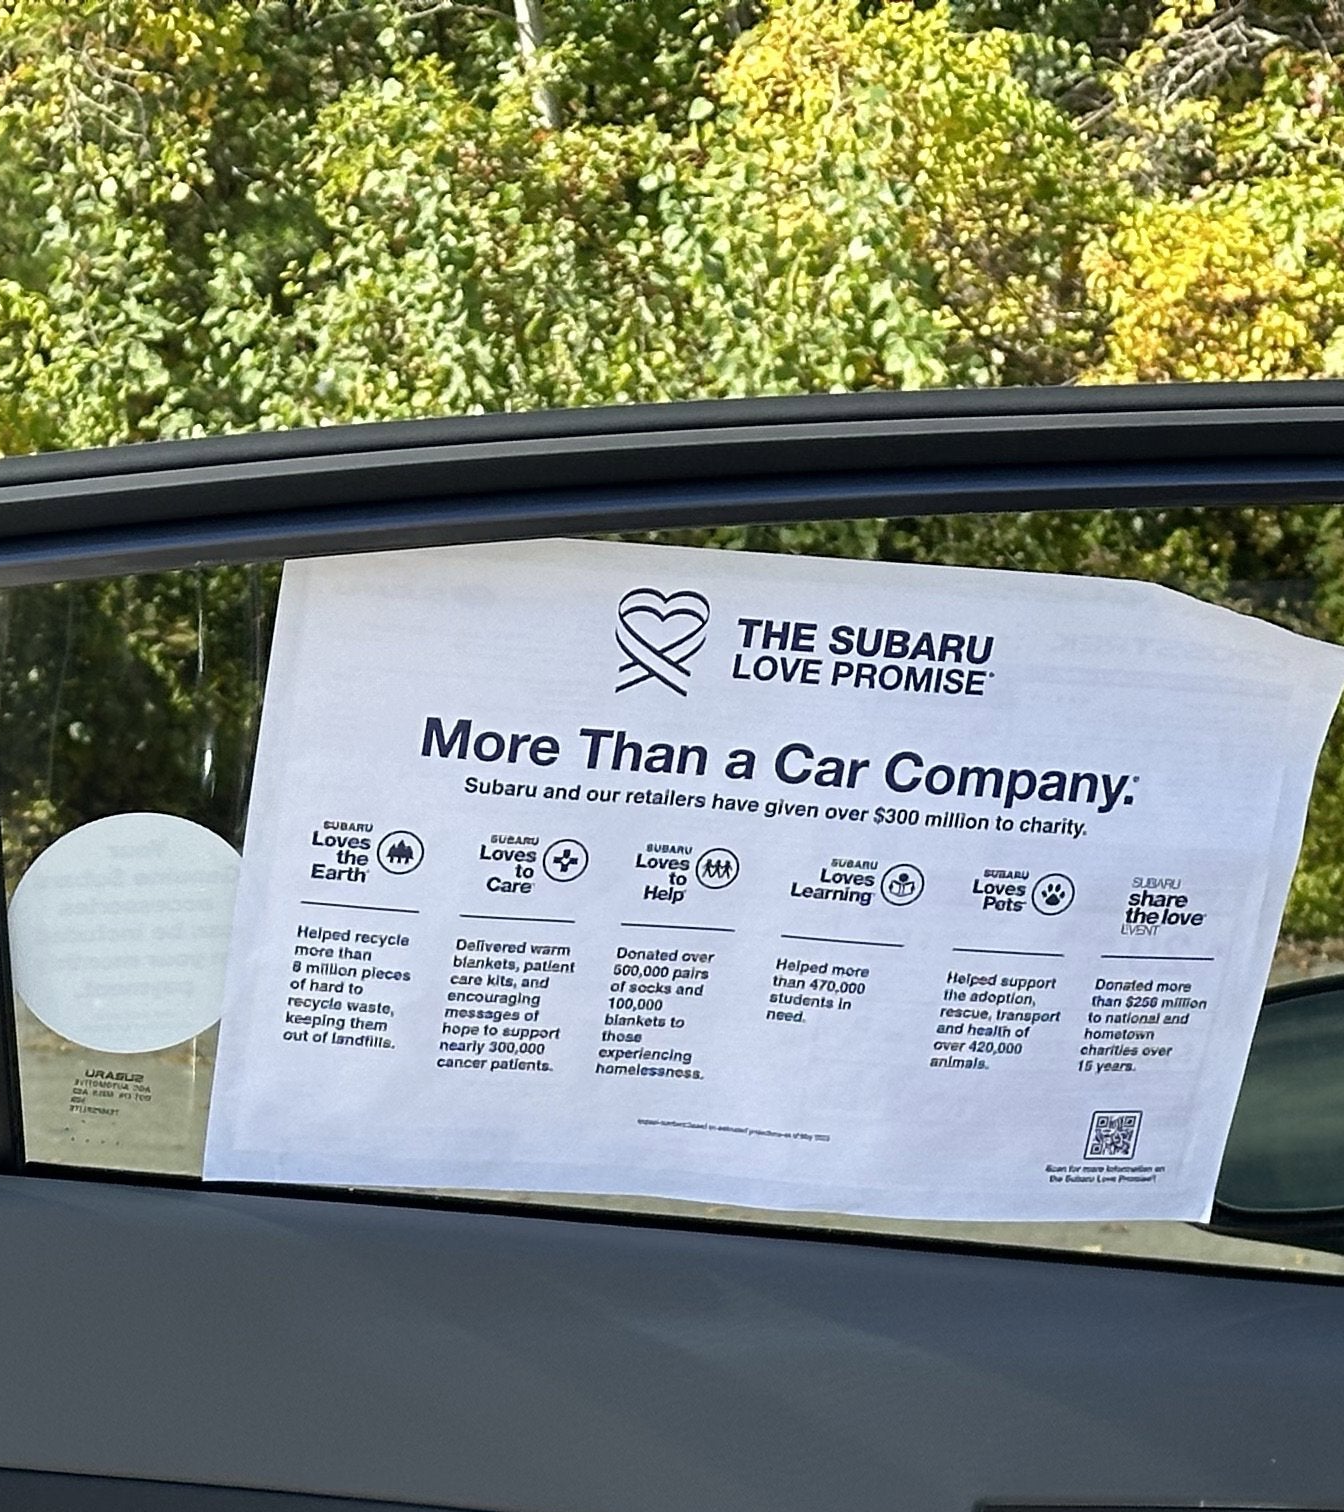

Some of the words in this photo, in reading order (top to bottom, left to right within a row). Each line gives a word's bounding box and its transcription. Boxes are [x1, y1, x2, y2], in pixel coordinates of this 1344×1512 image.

[737, 618, 817, 653] THE
[829, 626, 995, 664] SUBARU
[732, 655, 821, 686] LOVE
[420, 716, 560, 766] More
[578, 728, 708, 777] Than
[725, 748, 756, 780] a
[774, 744, 868, 792] Car
[464, 777, 538, 802] Subaru
[543, 783, 580, 803] and
[587, 788, 619, 804] our
[625, 787, 706, 809] retailers
[712, 795, 760, 815] have
[764, 798, 820, 821] given
[824, 807, 870, 824] over
[873, 805, 920, 829] $300
[924, 809, 990, 833] million
[995, 816, 1014, 832] to
[1019, 815, 1088, 838] charity.
[323, 820, 374, 833] SUBARU
[312, 831, 371, 850] Loves
[337, 849, 369, 866] the
[480, 845, 537, 862] Loves
[636, 854, 690, 870] Loves
[311, 864, 367, 883] Earth
[515, 864, 534, 879] to
[669, 871, 687, 886] to
[820, 869, 875, 887] Loves
[486, 877, 532, 894] Care
[791, 882, 873, 906] Learning
[973, 879, 1026, 897] Loves
[644, 886, 684, 904] Help
[1128, 890, 1188, 908] share
[983, 896, 1023, 912] Pets
[1126, 907, 1160, 924] the
[1162, 907, 1204, 926] love
[297, 925, 350, 943] Helped
[355, 931, 410, 948] recycle
[295, 945, 334, 958] more
[339, 947, 372, 962] than
[456, 938, 527, 954] Delivered
[530, 943, 571, 956] warm
[617, 947, 678, 963] Donated
[682, 951, 715, 964] over
[306, 963, 357, 978] million
[361, 967, 411, 982] pieces
[453, 956, 520, 972] blankets,
[523, 960, 575, 975] patient
[673, 967, 709, 981] pairs
[776, 958, 828, 976] Helped
[832, 965, 870, 978] more
[290, 979, 306, 991] of
[310, 980, 345, 994] hard
[349, 983, 363, 995] to
[450, 974, 483, 987] care
[486, 974, 517, 989] kits,
[521, 976, 549, 989] and
[611, 981, 626, 993] of
[629, 982, 672, 995] socks
[676, 983, 704, 996] and
[773, 976, 805, 990] than
[810, 980, 866, 995] 470,000
[947, 972, 997, 987] Helped
[1001, 974, 1056, 990] support
[1095, 979, 1153, 992] Donated
[1156, 982, 1191, 993] more
[448, 992, 540, 1008] encouraging
[608, 998, 663, 1012] 100,000
[769, 992, 834, 1009] students
[838, 997, 852, 1010] in
[944, 989, 966, 1002] the
[970, 990, 1036, 1006] adoption,
[1092, 996, 1121, 1008] than
[1161, 997, 1207, 1010] million
[288, 996, 342, 1013] recycle
[347, 1001, 395, 1017] waste,
[445, 1007, 520, 1022] messages
[524, 1009, 540, 1022] of
[285, 1012, 346, 1030] keeping
[350, 1017, 388, 1032] them
[605, 1014, 666, 1028] blankets
[670, 1016, 685, 1028] to
[766, 1009, 806, 1024] need.
[940, 1008, 992, 1022] rescue,
[996, 1010, 1061, 1024] transport
[1088, 1012, 1102, 1024] to
[1105, 1012, 1160, 1025] national
[1163, 1013, 1189, 1025] and
[442, 1023, 479, 1038] hope
[483, 1025, 498, 1037] to
[502, 1027, 561, 1041] support
[602, 1030, 642, 1043] those
[936, 1023, 963, 1035] and
[968, 1024, 1011, 1038] health
[1015, 1026, 1031, 1038] of
[1084, 1028, 1155, 1041] hometown
[283, 1031, 309, 1044] out
[312, 1032, 329, 1044] of
[331, 1032, 396, 1049] landfills.
[439, 1040, 485, 1055] nearly
[489, 1041, 545, 1056] 300,000
[934, 1041, 965, 1052] over
[969, 1042, 1022, 1055] 420,000
[599, 1047, 692, 1065] experiencing
[1080, 1045, 1138, 1057] charities
[1142, 1046, 1173, 1057] over
[437, 1057, 486, 1070] cancer
[491, 1058, 554, 1073] patients.
[595, 1063, 704, 1080] homelessness.
[930, 1057, 989, 1070] animals.
[1096, 1061, 1136, 1075] years.
